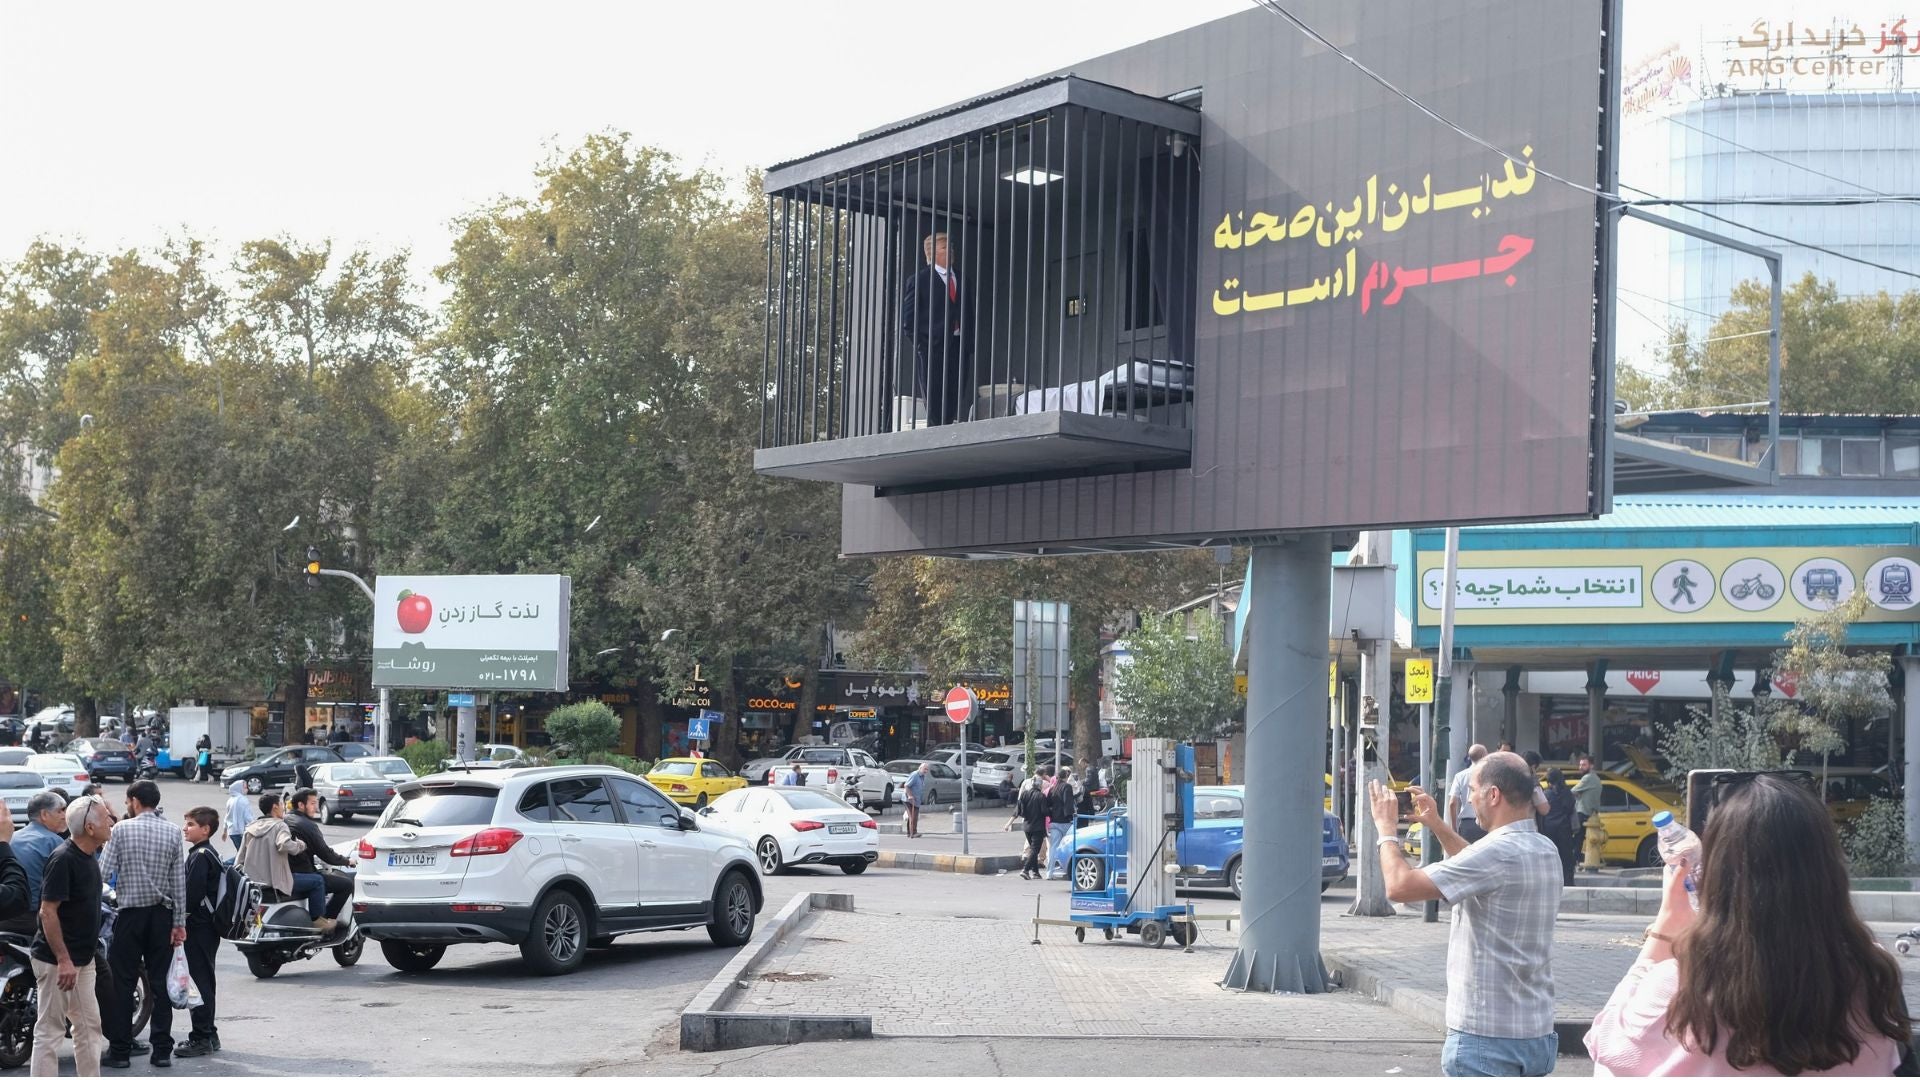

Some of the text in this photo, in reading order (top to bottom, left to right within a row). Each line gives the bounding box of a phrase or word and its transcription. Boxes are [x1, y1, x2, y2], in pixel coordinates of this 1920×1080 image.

[1728, 57, 1885, 78] ARG Center
[1213, 144, 1537, 250] ندیدن این صحنه
[1212, 233, 1535, 316] جرم است
[1507, 575, 1551, 594] شما
[1555, 577, 1635, 600] انتخاب
[469, 601, 503, 623] گاز
[508, 602, 539, 619] لذت
[390, 656, 436, 673] روشا
[479, 654, 499, 662] تکمیلی
[748, 698, 796, 710] COCO CAFE
